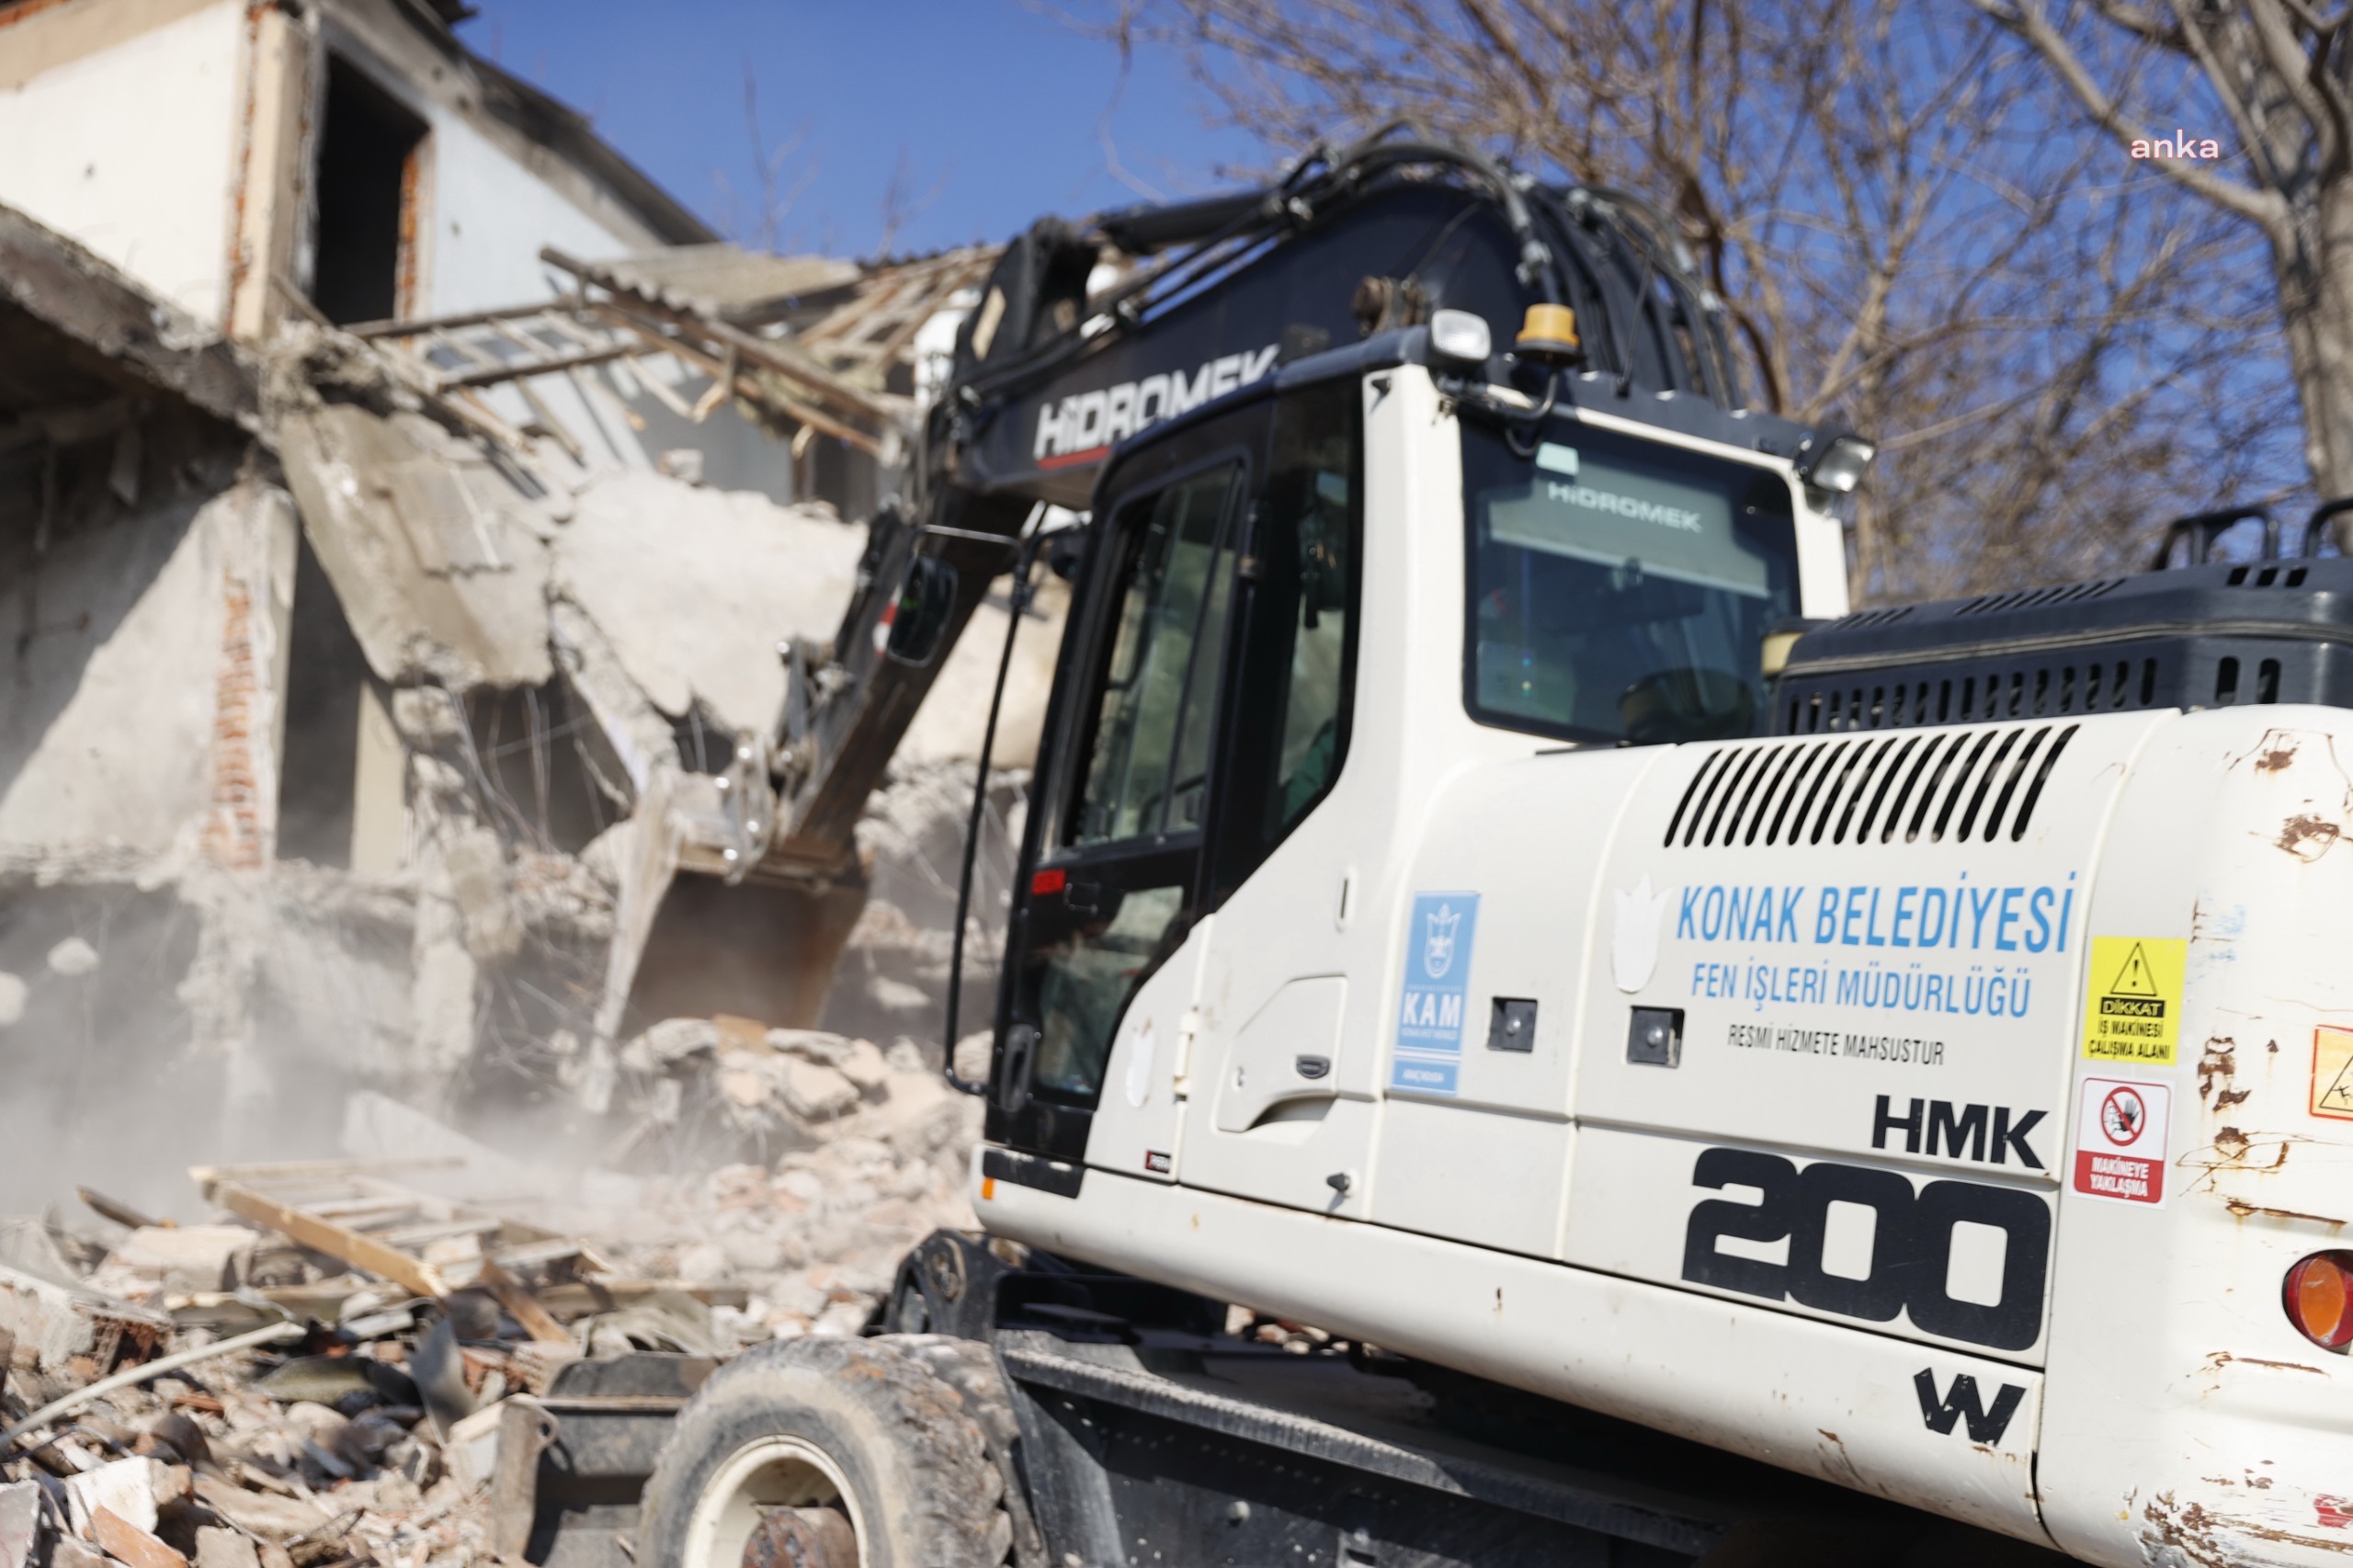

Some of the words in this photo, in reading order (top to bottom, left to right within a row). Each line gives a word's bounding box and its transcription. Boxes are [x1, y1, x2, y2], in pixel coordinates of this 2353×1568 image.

[1677, 885, 1805, 944] KONAK
[1814, 871, 2077, 953] BELEDİYESİ
[1403, 993, 1461, 1027] KAM
[1692, 962, 1738, 999] FEN
[1745, 956, 1829, 1011] İŞLERİ
[1838, 960, 2031, 1017] MÜDÜRLÜĞÜ
[2102, 998, 2163, 1017] DİKKAT
[1775, 1023, 1840, 1056] HİZMETE
[1843, 1033, 1945, 1066] MAHSUSTUR
[1871, 1094, 2050, 1170] HMK
[2089, 1173, 2149, 1199] YAKLAŞMA
[2090, 1155, 2150, 1179] MAKİNEYE
[1680, 1146, 2052, 1352] 200
[1913, 1367, 2027, 1447] W
